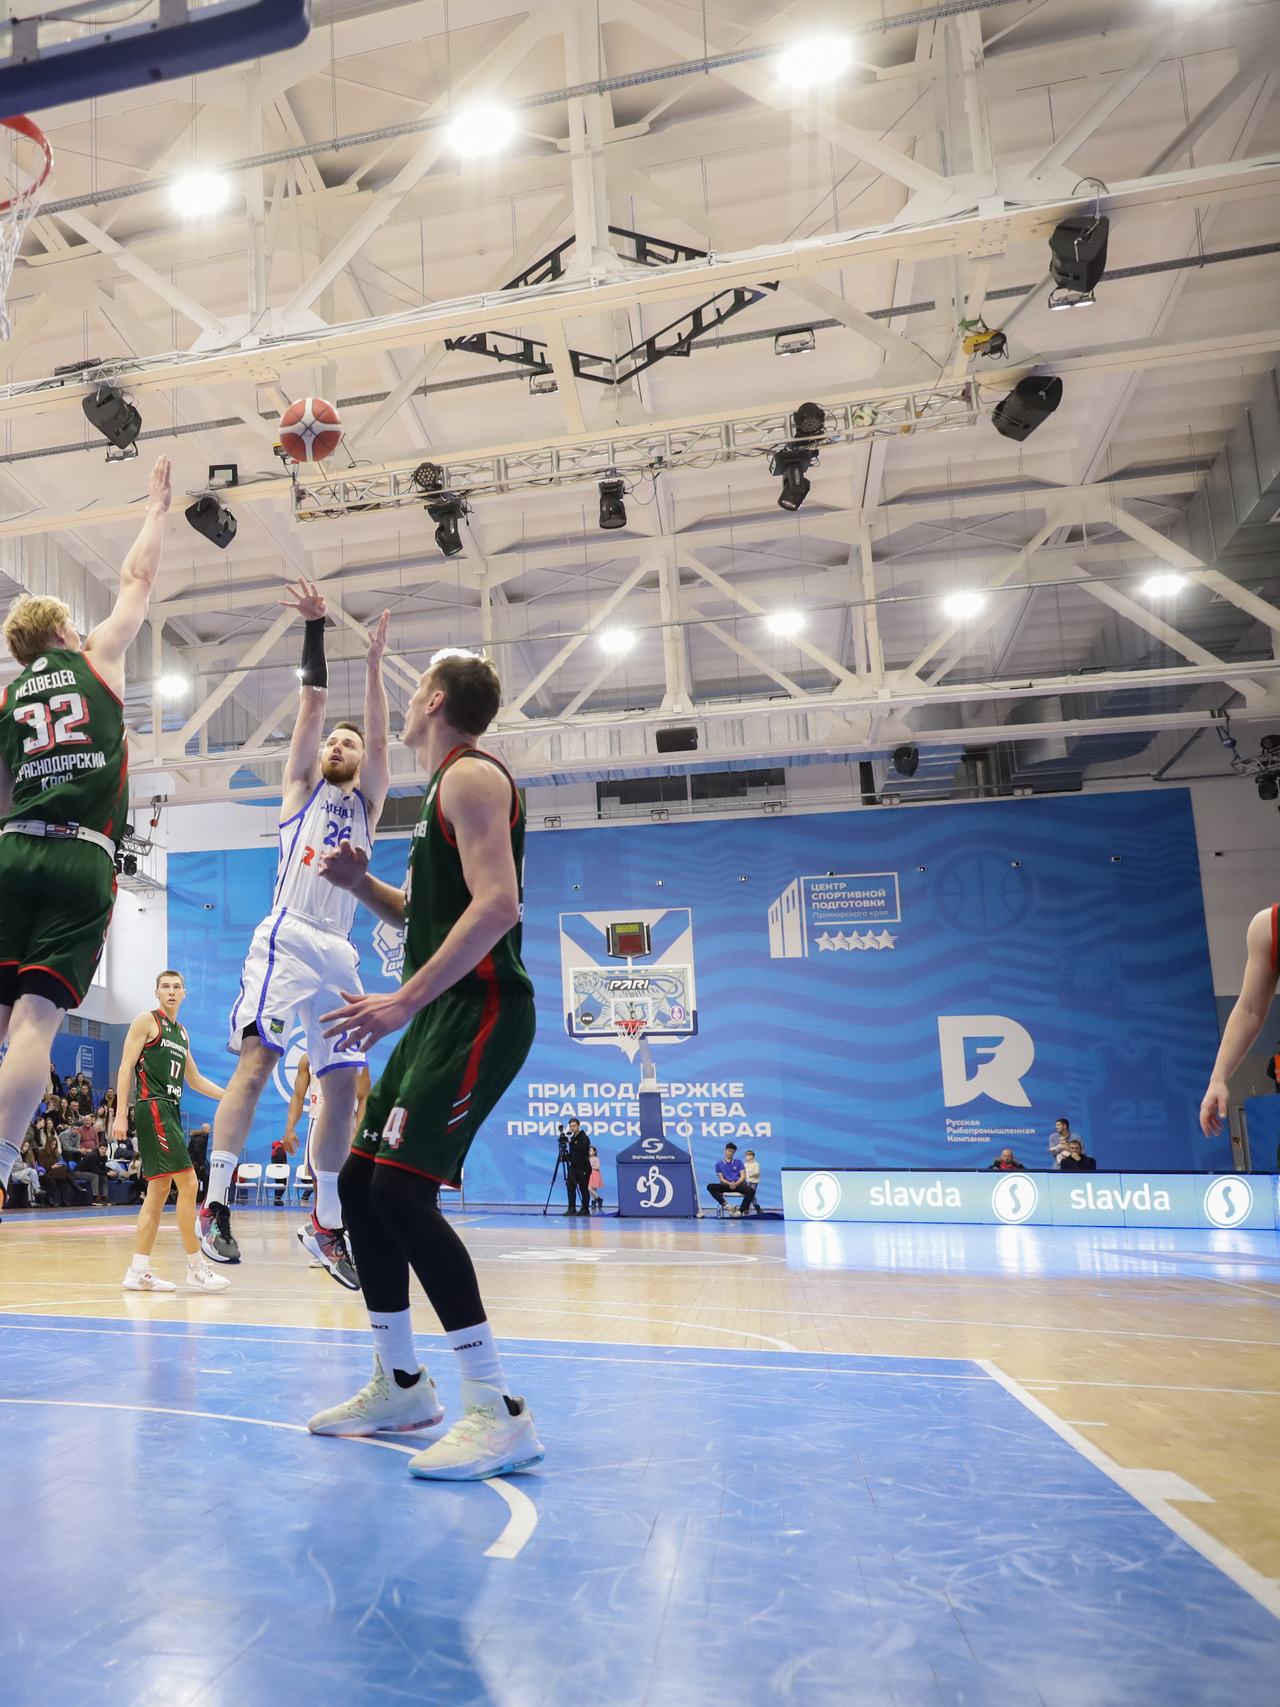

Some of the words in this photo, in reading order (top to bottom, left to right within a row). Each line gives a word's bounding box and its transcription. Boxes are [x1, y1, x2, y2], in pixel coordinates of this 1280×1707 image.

[15, 669, 76, 700] МЕДВЕДЕВ
[13, 692, 93, 755] 32
[323, 820, 351, 848] 26
[811, 882, 847, 892] ЦЕНТР
[811, 888, 886, 900] СПОРТИВНОЙ
[812, 899, 885, 910] ПОДГОТОВКИ
[813, 910, 868, 919] Приморского
[870, 910, 889, 918] края
[609, 979, 650, 990] PARI
[170, 1060, 181, 1079] 17
[528, 1083, 576, 1098] ПРИ
[583, 1082, 744, 1100] ПОДЕРЖКЕ
[528, 1102, 746, 1117] ПРАВИТЕЬСТВА
[382, 1107, 408, 1148] 4
[507, 1121, 693, 1137] ПРИОРСКГО
[702, 1122, 771, 1137] КРАЯ
[946, 1119, 980, 1127] Русская
[947, 1127, 1035, 1135] Рыбопромышленная
[870, 1180, 961, 1208] slavda
[1070, 1182, 1171, 1211] slavda
